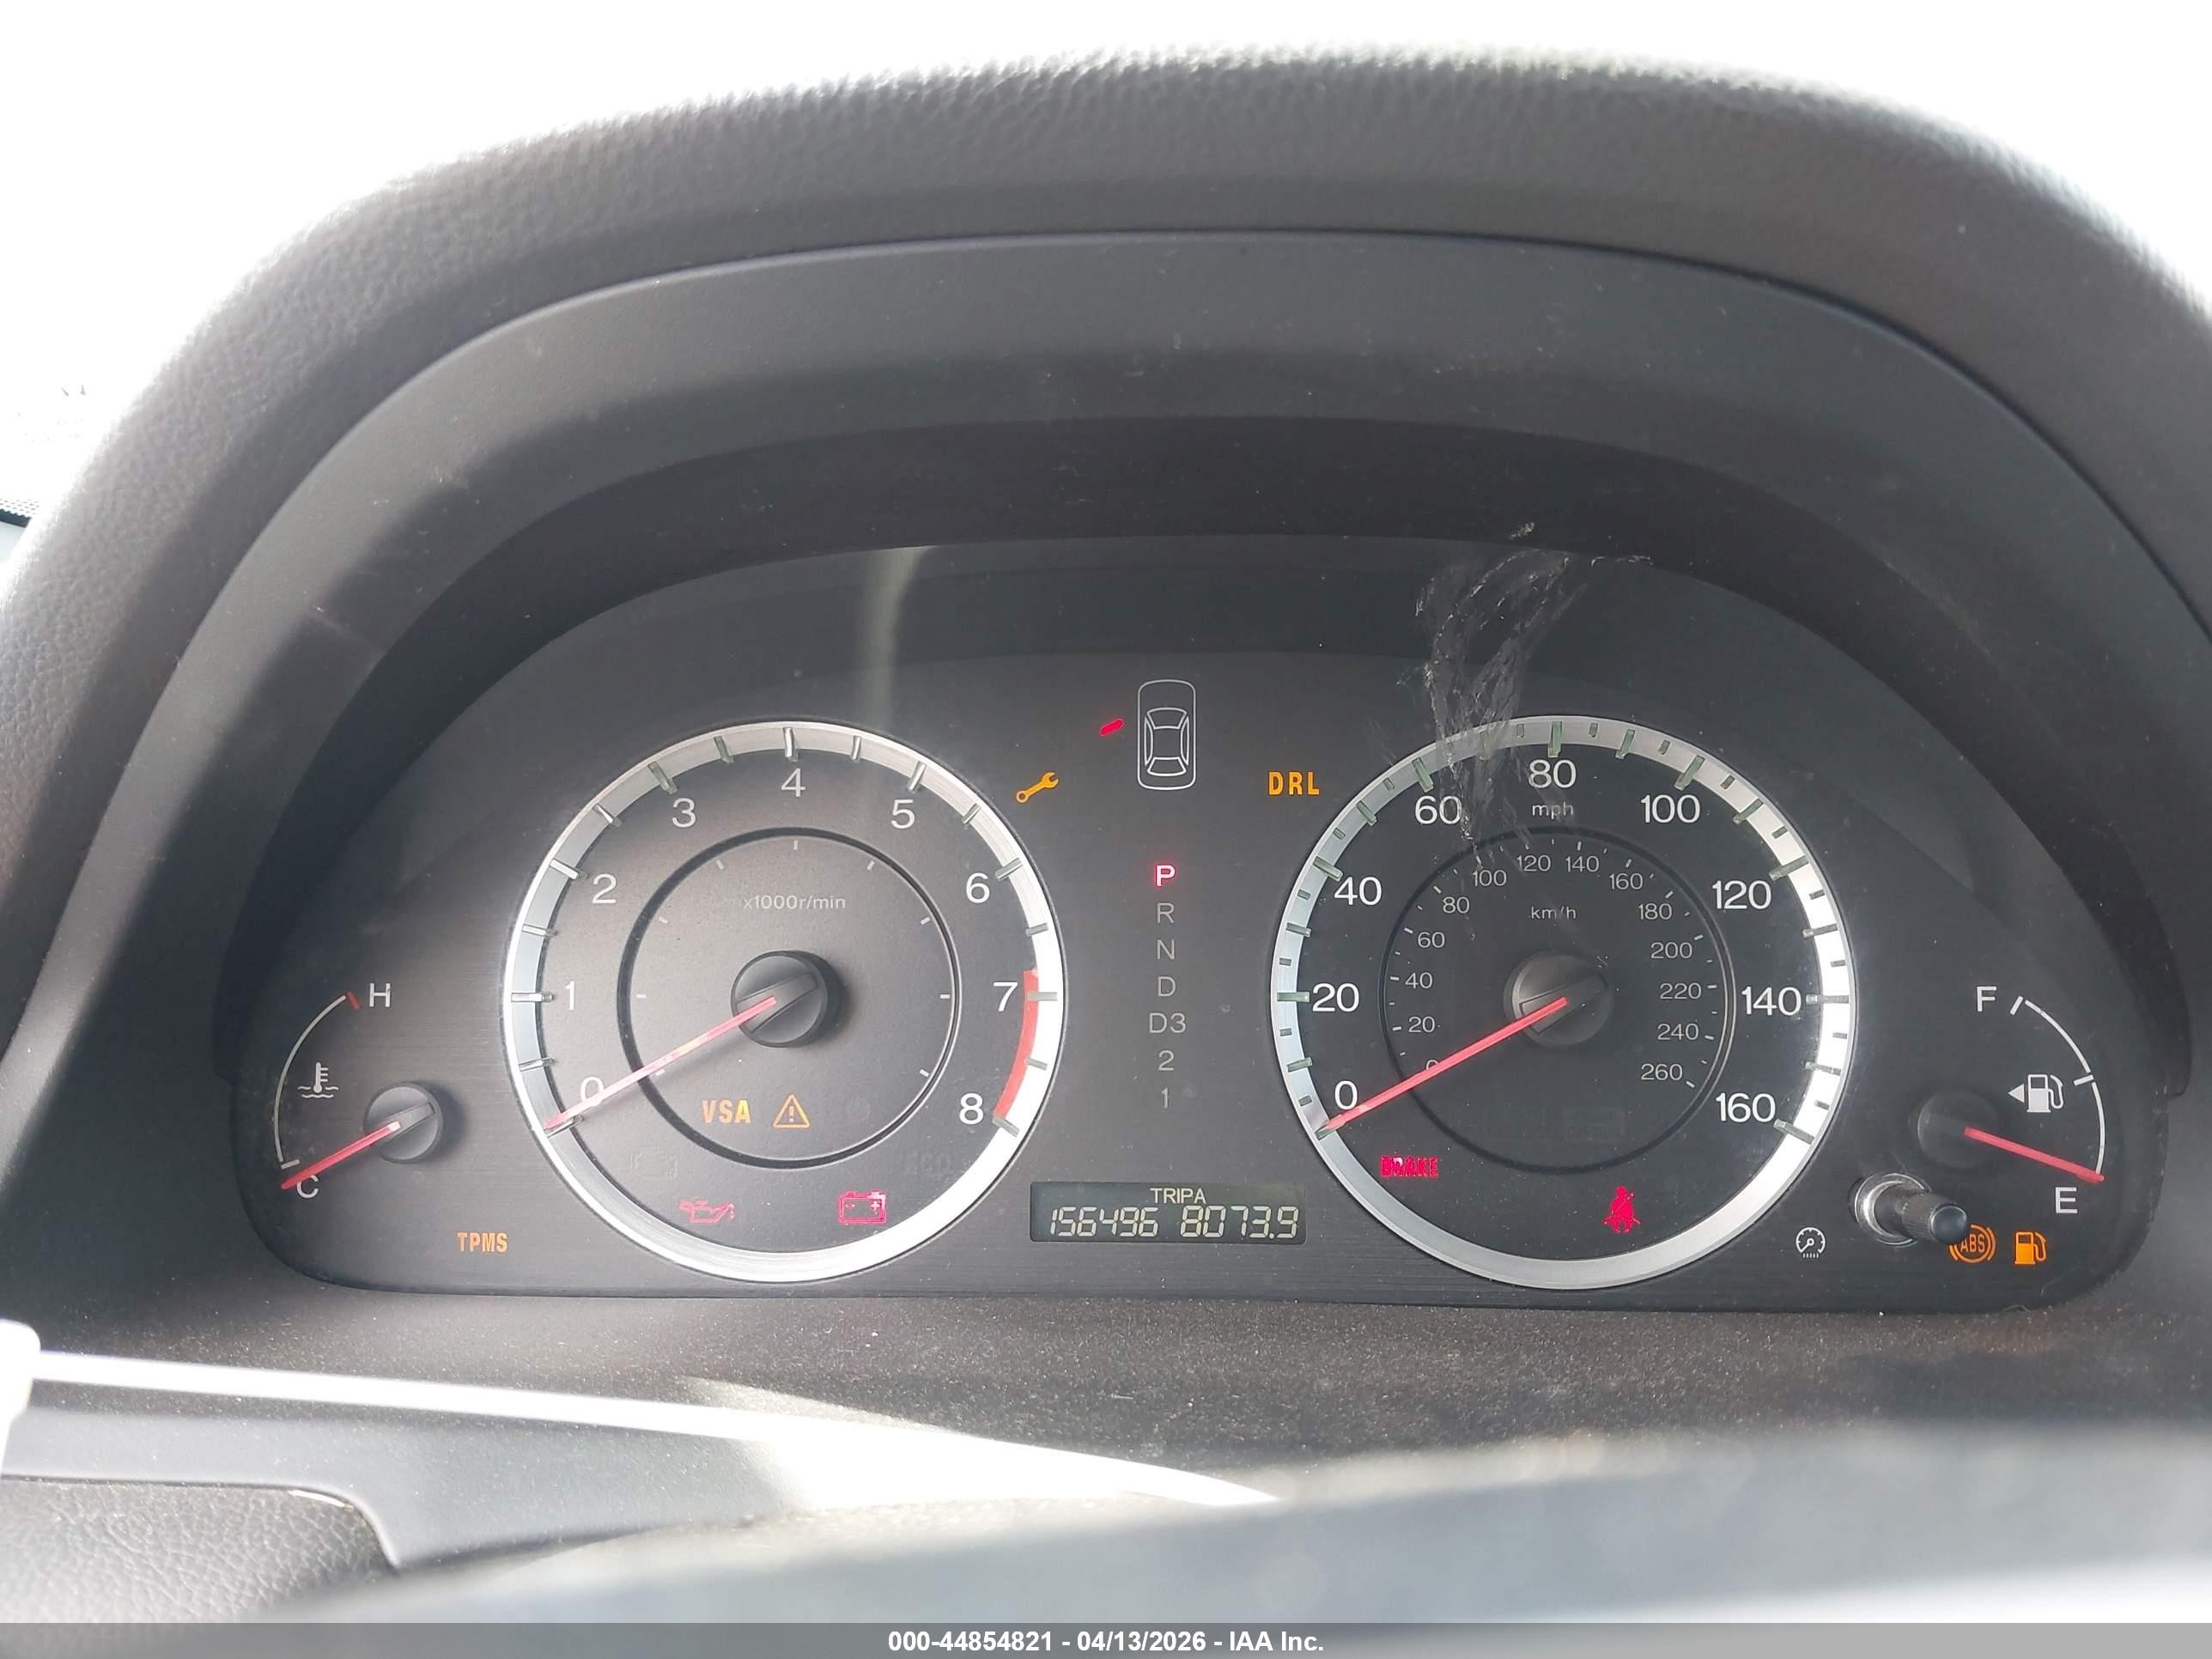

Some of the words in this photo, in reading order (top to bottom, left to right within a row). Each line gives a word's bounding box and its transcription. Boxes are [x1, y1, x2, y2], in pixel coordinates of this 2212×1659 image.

[781, 769, 805, 797] 4
[1269, 772, 1319, 794] DRL
[1528, 759, 1576, 788] 80
[672, 799, 696, 827] 3
[891, 799, 915, 829] 5
[1416, 796, 1462, 824] 60
[1533, 802, 1573, 819] mph
[1641, 795, 1699, 823] 100
[1517, 855, 1551, 871] 120
[1566, 856, 1599, 872] 140
[1154, 866, 1175, 886] P
[1473, 870, 1506, 886] 100
[1610, 873, 1643, 889] 160
[592, 874, 616, 903] 2
[967, 873, 989, 902] 6
[1334, 876, 1382, 905] 40
[1712, 880, 1772, 908] 120
[744, 895, 845, 909] x1000r/min
[1443, 897, 1469, 913] 80
[1639, 903, 1672, 920] 180
[1158, 903, 1174, 923] R
[1532, 907, 1576, 918] km/h
[1158, 939, 1174, 959] N
[1419, 933, 1444, 947] 60
[1651, 942, 1692, 958] 200
[1158, 976, 1176, 996] D
[1406, 973, 1432, 988] 40
[370, 983, 390, 1007] H
[566, 981, 574, 1010] 1
[994, 982, 1018, 1011] 7
[1313, 983, 1358, 1012] 20
[1661, 983, 1701, 999] 220
[1742, 987, 1801, 1015] 140
[1977, 987, 1996, 1012] F
[1150, 1013, 1186, 1033] D3
[1409, 1017, 1435, 1032] 20
[1658, 1024, 1698, 1040] 240
[1158, 1050, 1174, 1071] 2
[1642, 1064, 1682, 1080] 260
[1162, 1088, 1168, 1108] 1
[1334, 1080, 1358, 1110] 0
[702, 1100, 750, 1123] VSA
[960, 1093, 983, 1124] 8
[1716, 1093, 1776, 1122] 160
[1382, 1158, 1437, 1176] BRAKE
[2056, 1188, 2077, 1213] E
[1051, 1207, 1158, 1237] 156496
[458, 1233, 507, 1252] TPMS
[1960, 1233, 1985, 1253] ABS
